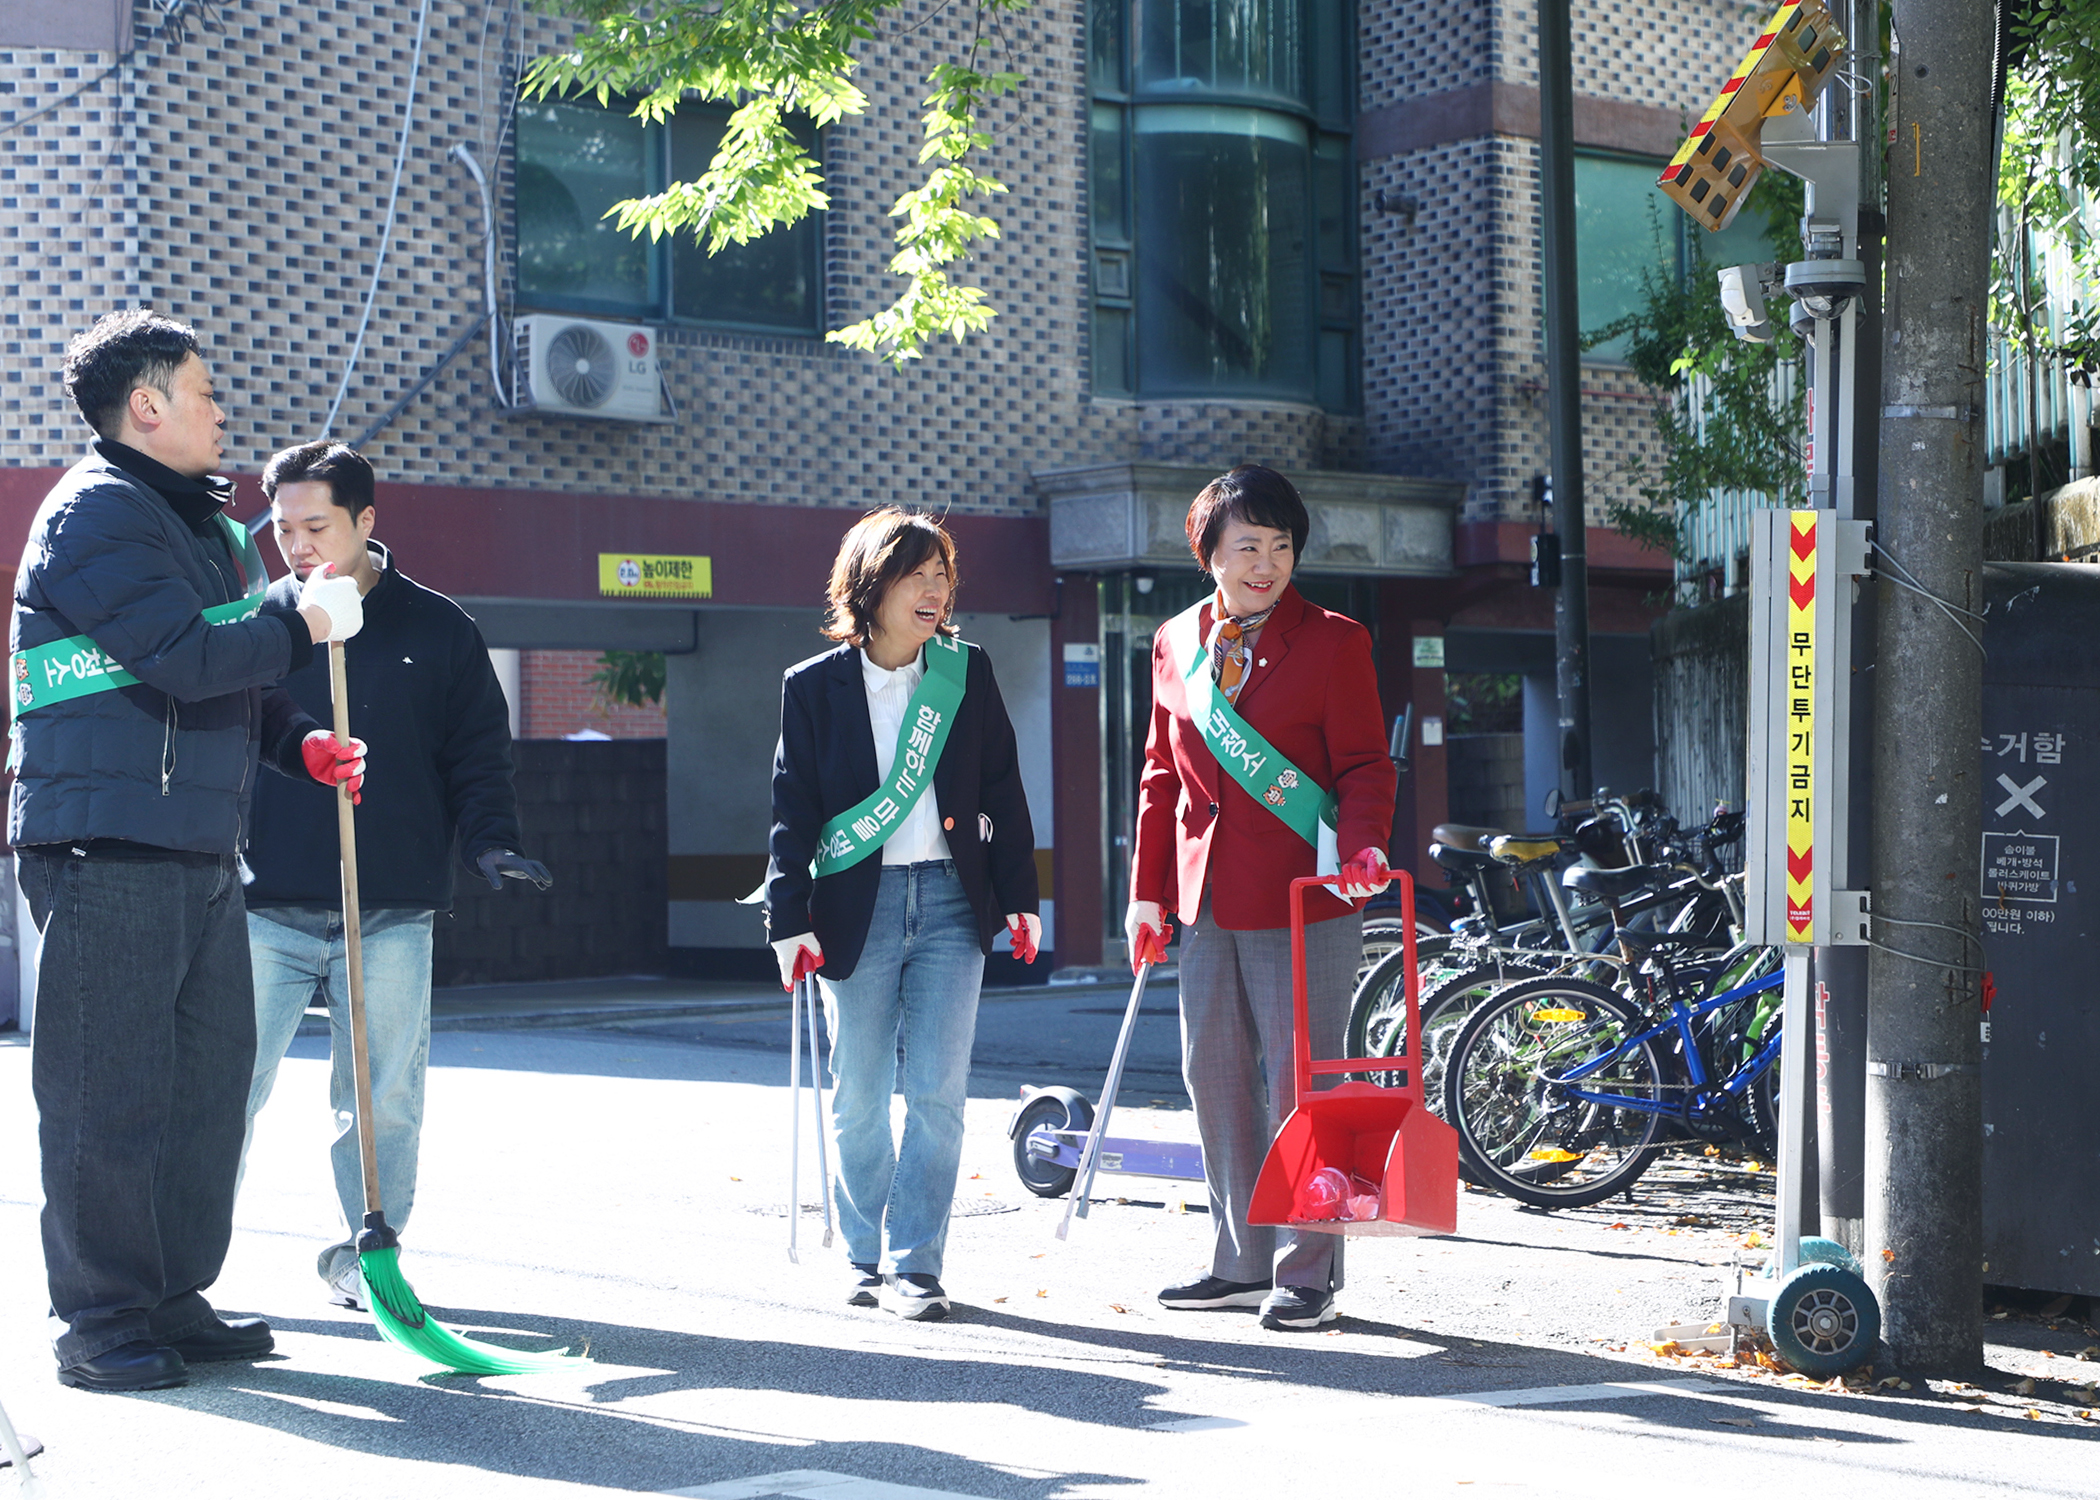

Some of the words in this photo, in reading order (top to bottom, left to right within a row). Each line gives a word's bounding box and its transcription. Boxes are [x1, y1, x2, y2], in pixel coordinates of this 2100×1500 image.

[629, 361, 647, 375] LG
[643, 560, 693, 579] 높이제한
[895, 704, 942, 798] 함께하는
[1206, 707, 1267, 778] 대청소
[851, 796, 900, 842] 마을
[1987, 868, 2051, 881] 롤러스케이트
